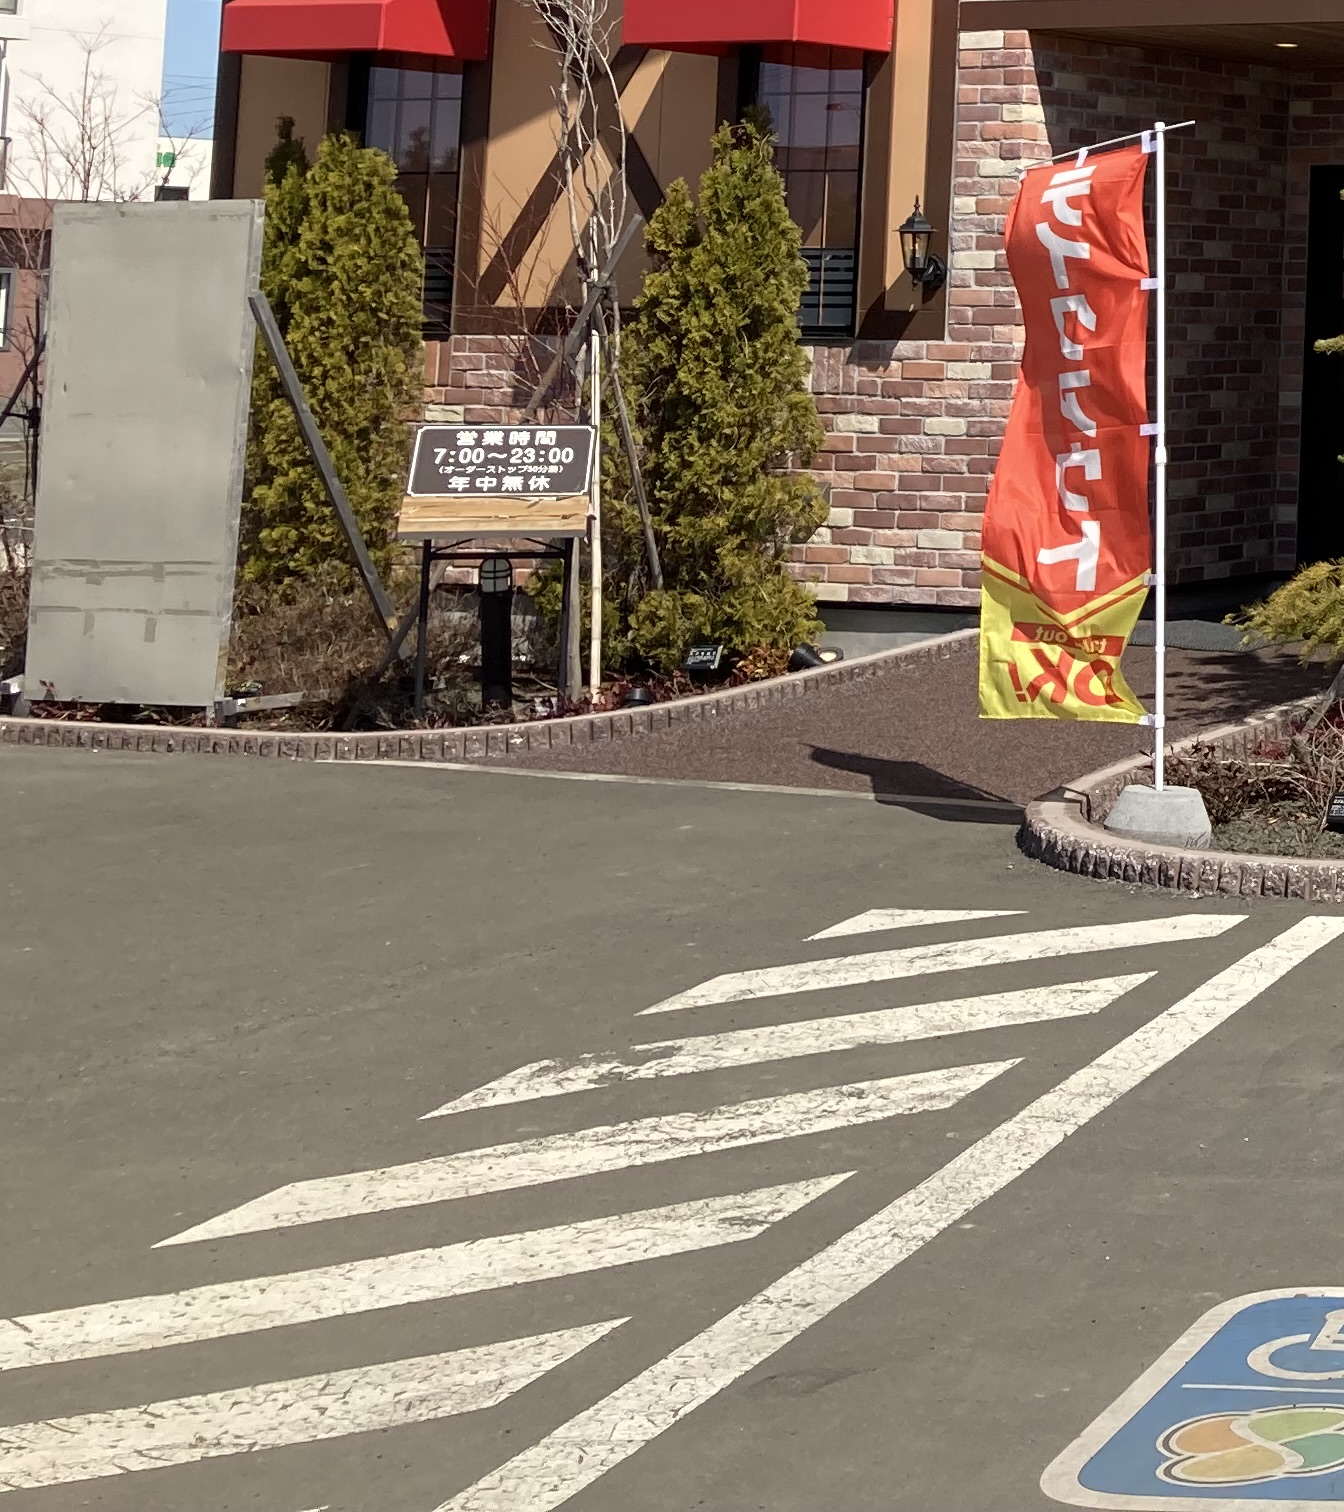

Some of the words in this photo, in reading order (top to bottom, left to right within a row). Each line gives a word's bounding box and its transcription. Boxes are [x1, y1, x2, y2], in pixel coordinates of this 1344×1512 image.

[456, 430, 557, 446] 営業時間
[447, 475, 551, 492] 年中無休
